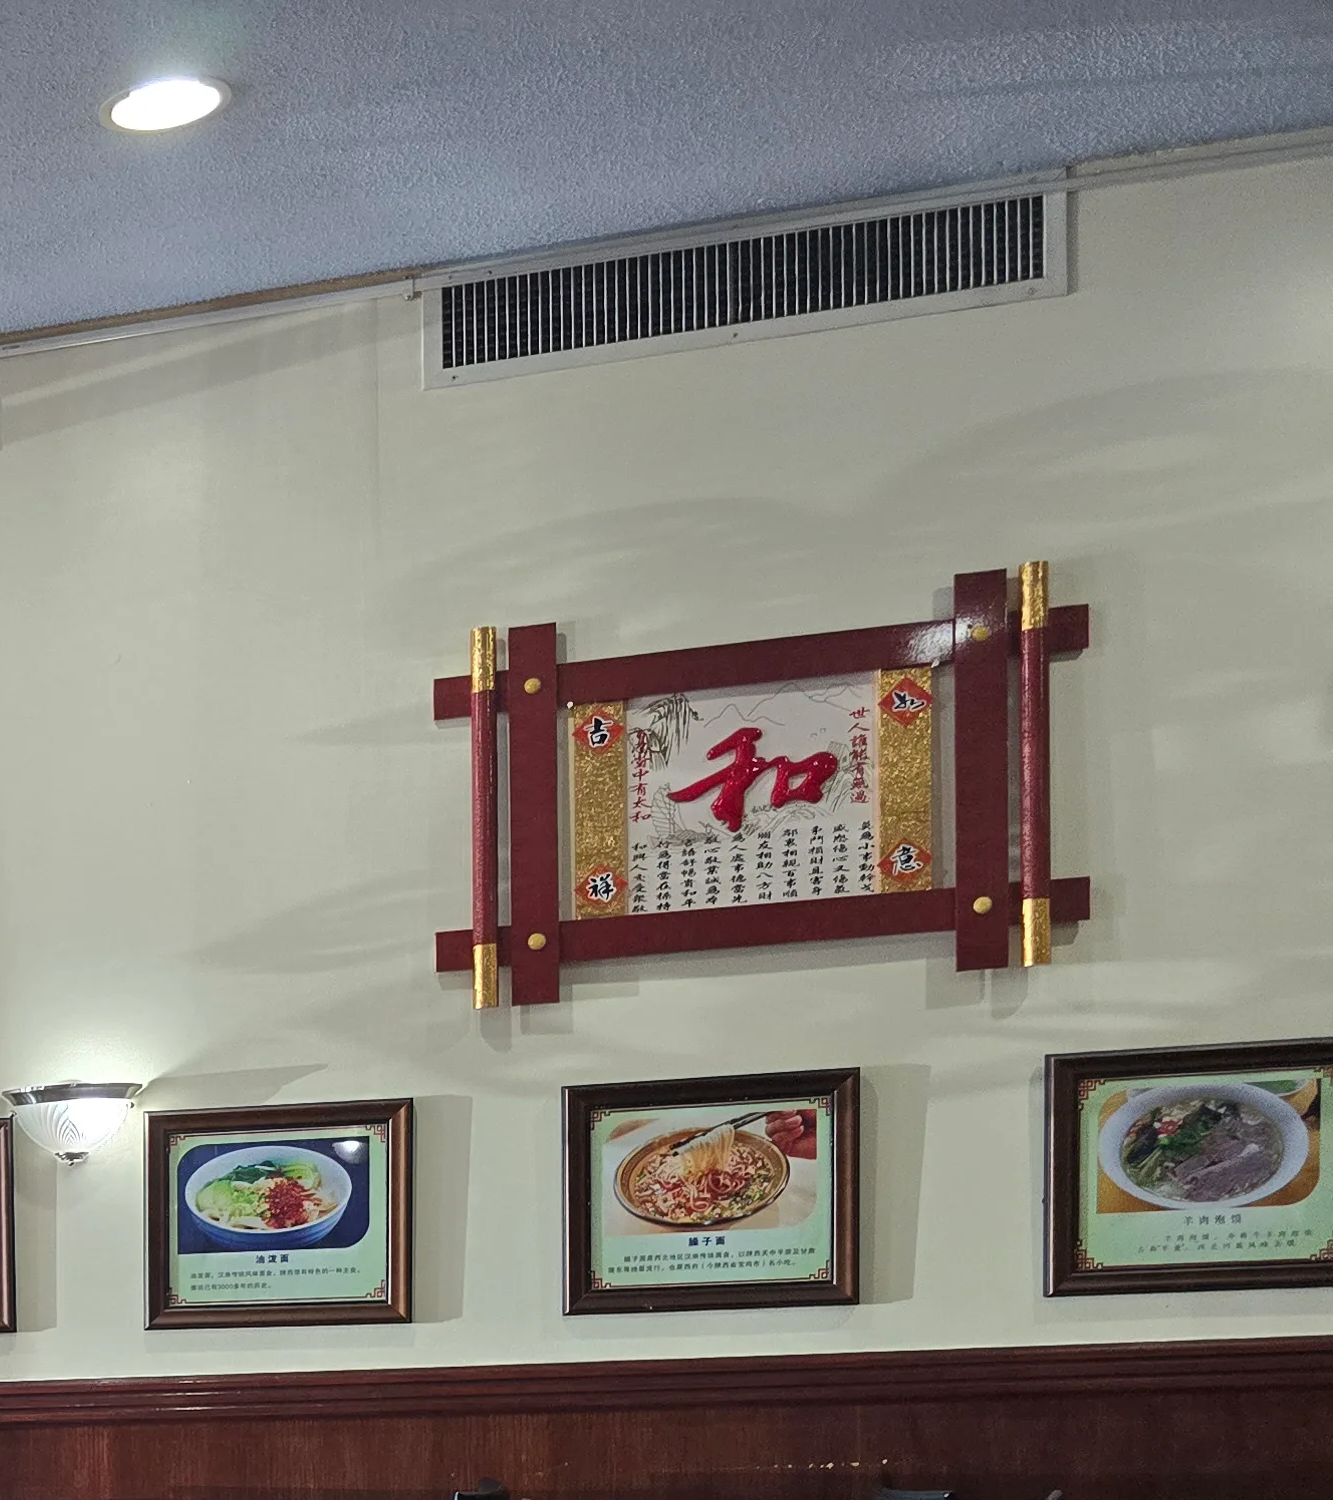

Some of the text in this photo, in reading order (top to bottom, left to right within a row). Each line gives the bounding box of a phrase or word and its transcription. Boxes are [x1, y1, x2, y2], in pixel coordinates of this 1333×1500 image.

[586, 720, 609, 747] 吉
[668, 728, 837, 832] 和
[891, 846, 924, 876] 意
[587, 873, 615, 901] 祥
